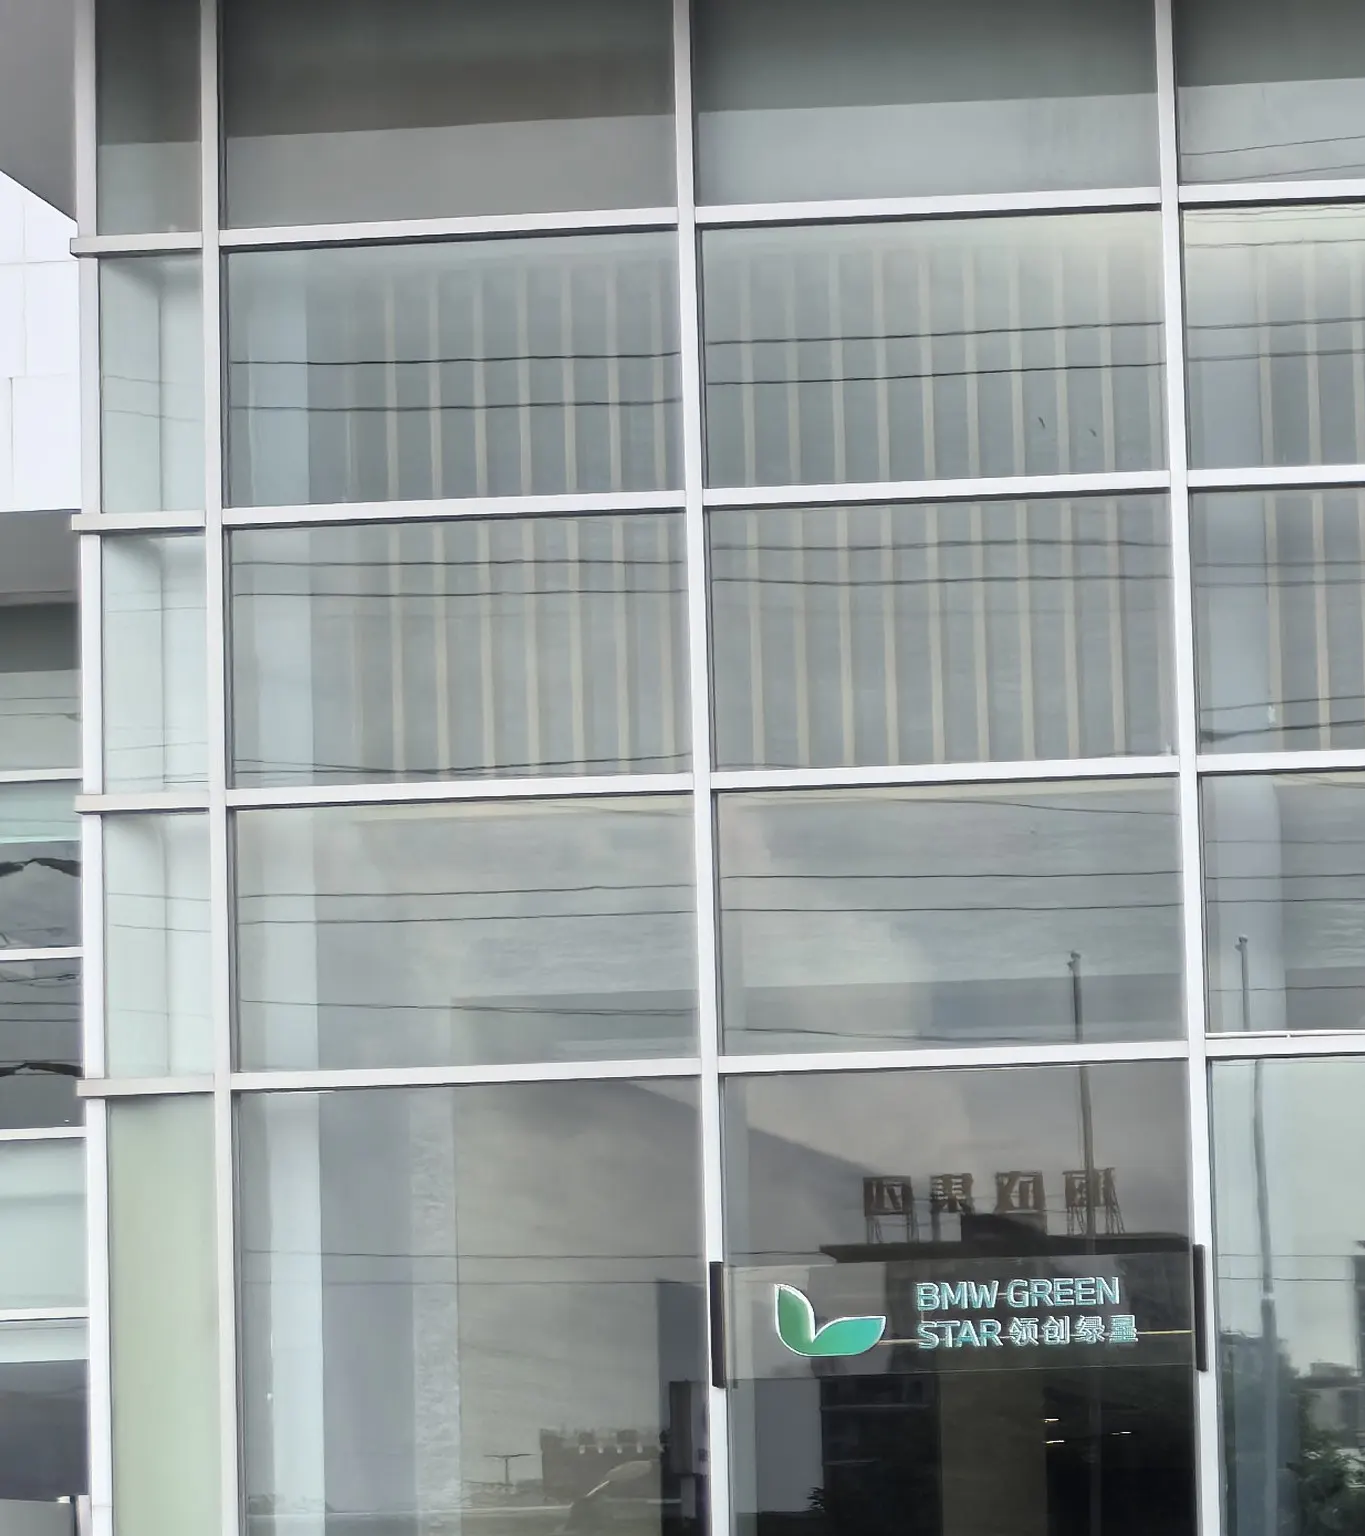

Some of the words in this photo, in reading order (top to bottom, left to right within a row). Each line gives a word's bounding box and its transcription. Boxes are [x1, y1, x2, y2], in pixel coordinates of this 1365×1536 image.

[916, 1279, 999, 1312] BMW
[1006, 1276, 1120, 1308] GREEN
[917, 1317, 1003, 1350] STAR
